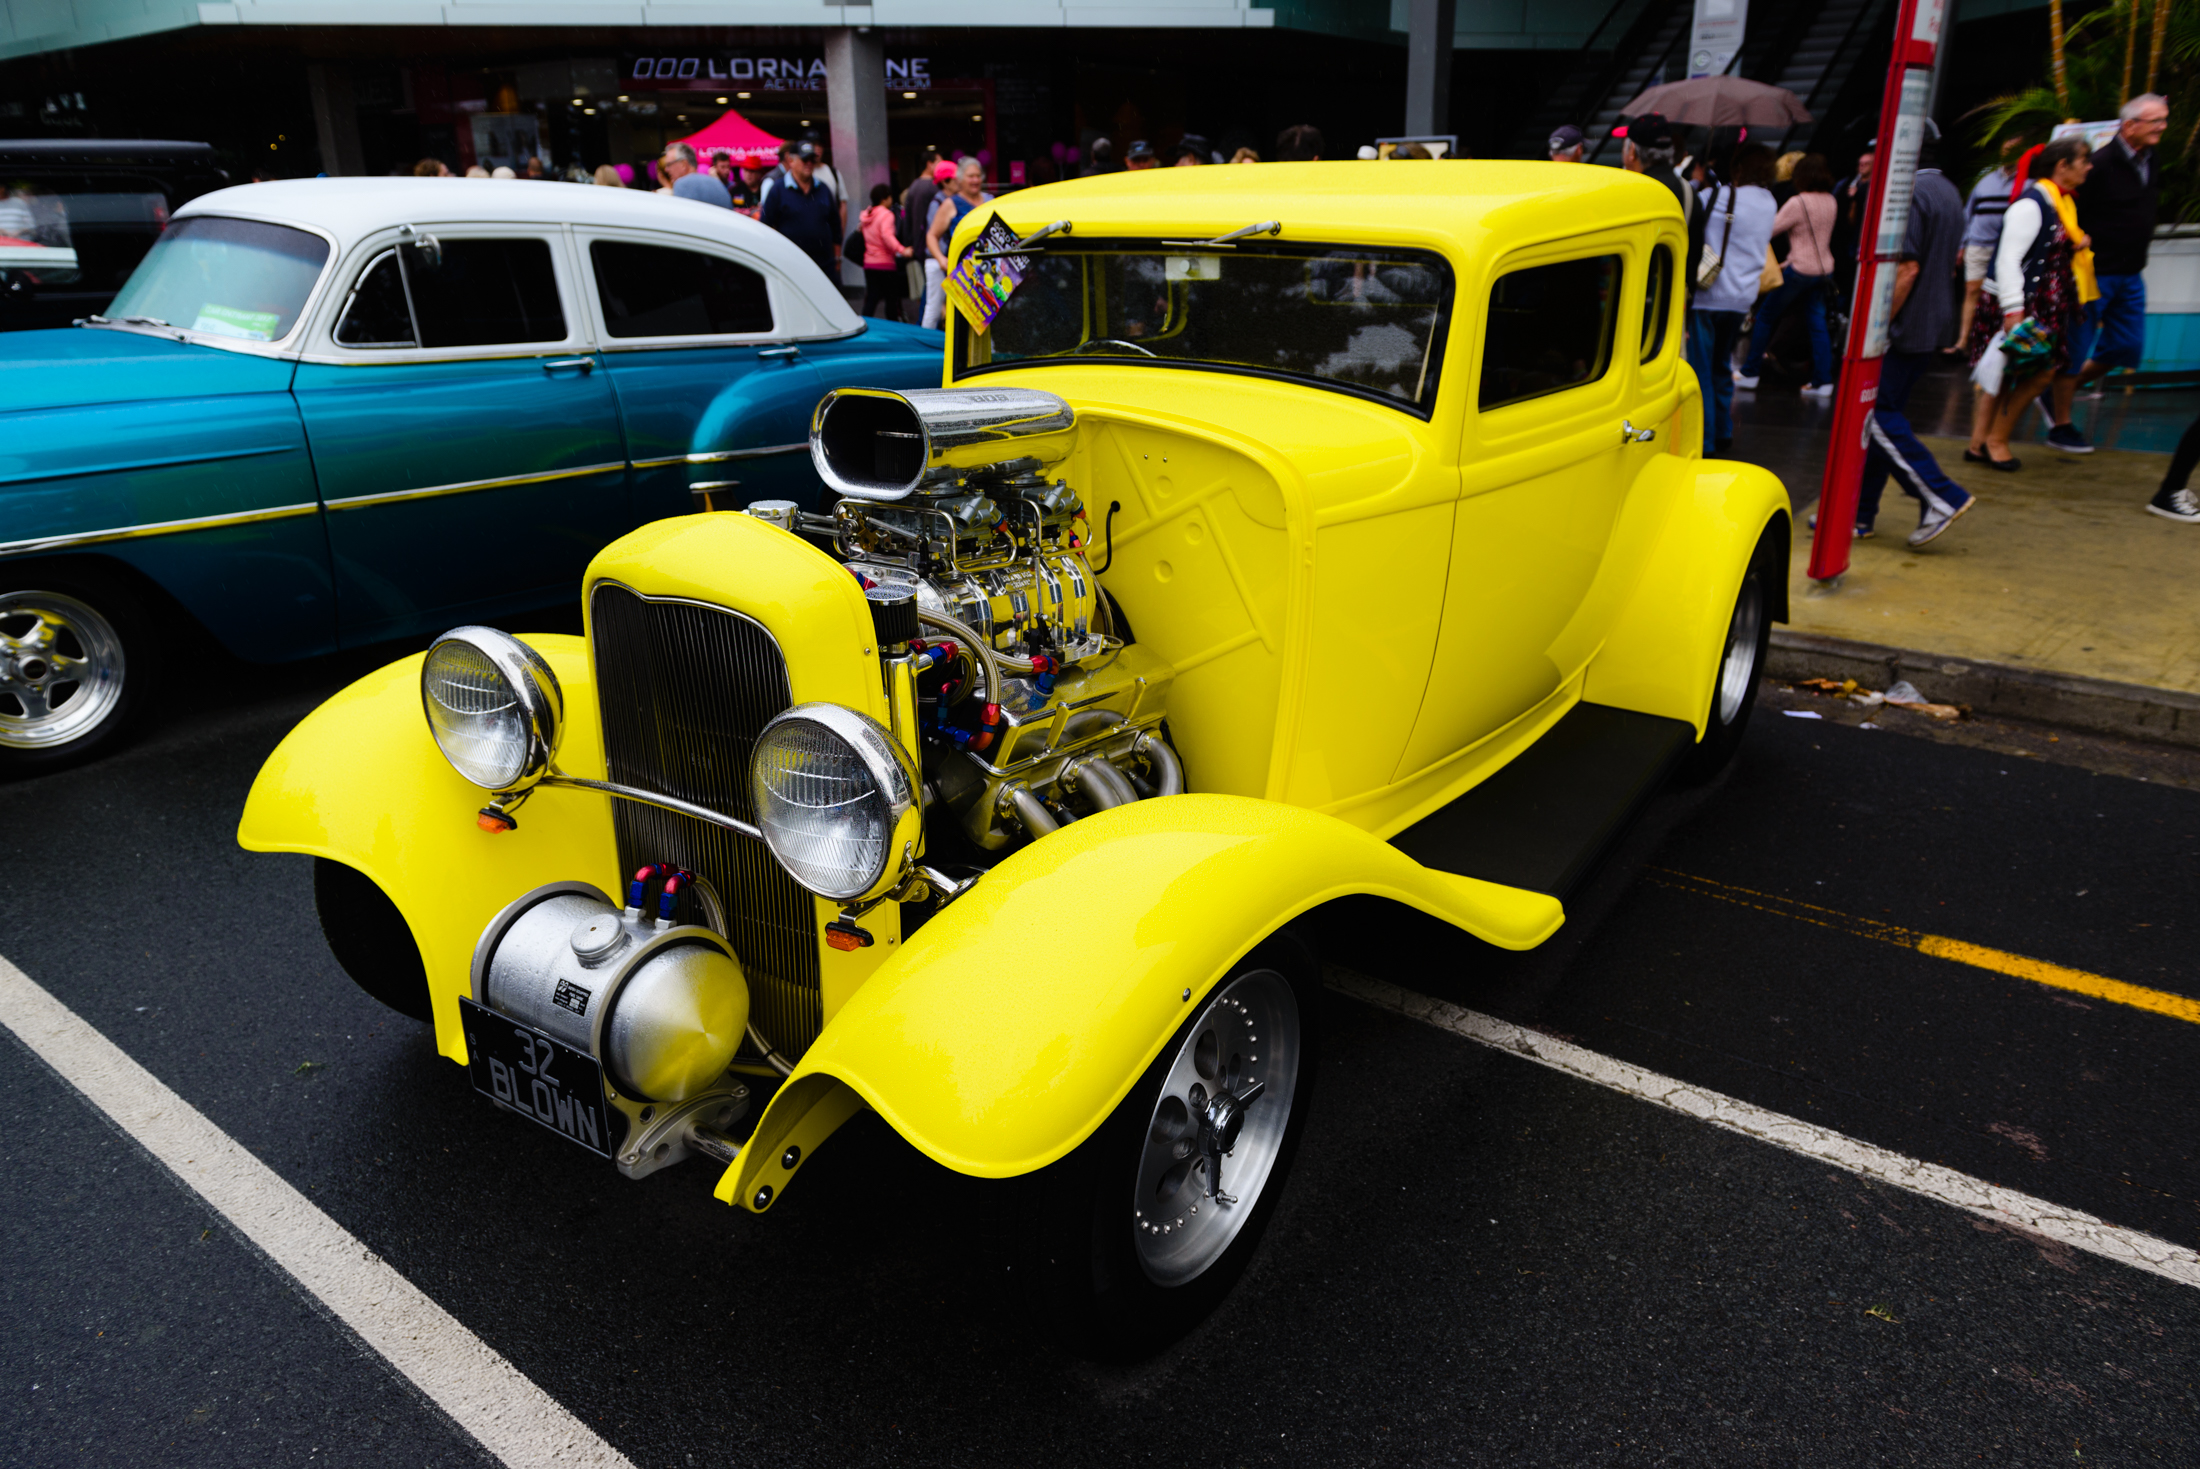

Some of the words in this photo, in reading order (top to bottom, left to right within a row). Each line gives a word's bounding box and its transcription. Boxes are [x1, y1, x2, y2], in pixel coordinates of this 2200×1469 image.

[707, 57, 828, 79] LORNA
[885, 58, 930, 79] NE
[764, 78, 820, 91] ACTIVE
[698, 145, 746, 158] LORNA
[989, 226, 1005, 245] CAR
[993, 221, 1011, 243] GOLD
[514, 1028, 560, 1088] 32
[489, 1056, 600, 1149] BLOWN
